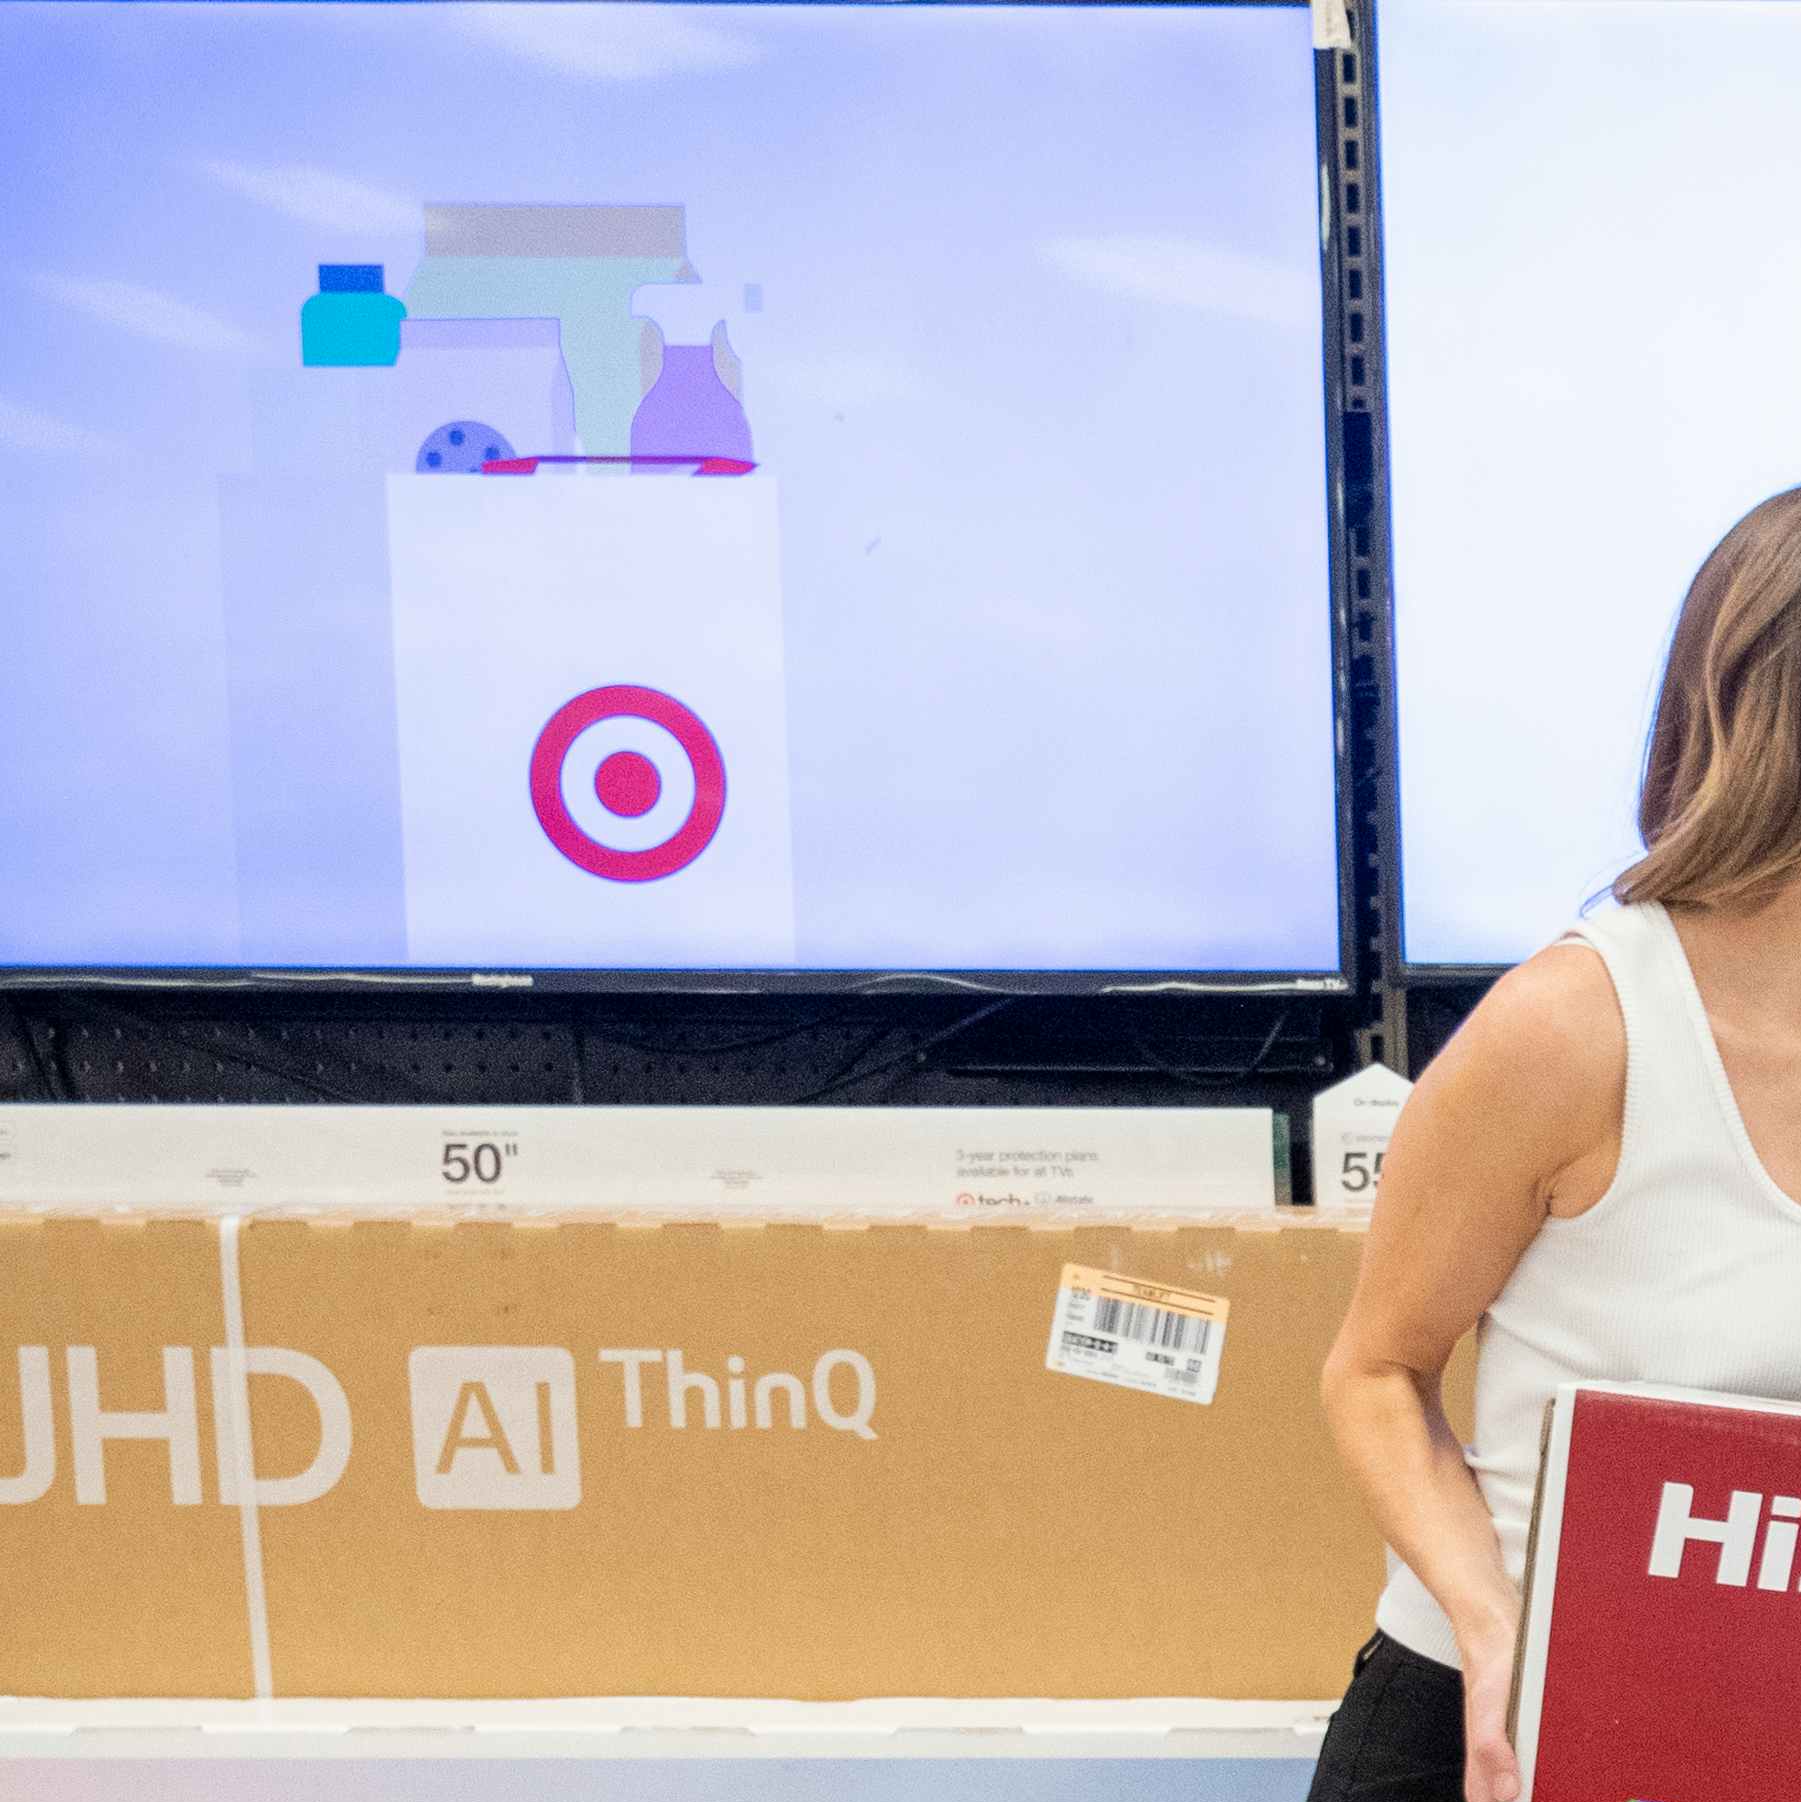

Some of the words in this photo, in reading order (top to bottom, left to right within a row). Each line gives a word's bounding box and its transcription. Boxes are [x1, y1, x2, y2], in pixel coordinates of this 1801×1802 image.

[442, 1143, 519, 1184] 50"
[999, 1149, 1062, 1163] protection
[599, 1348, 879, 1440] ThinQ
[435, 1381, 557, 1476] AI
